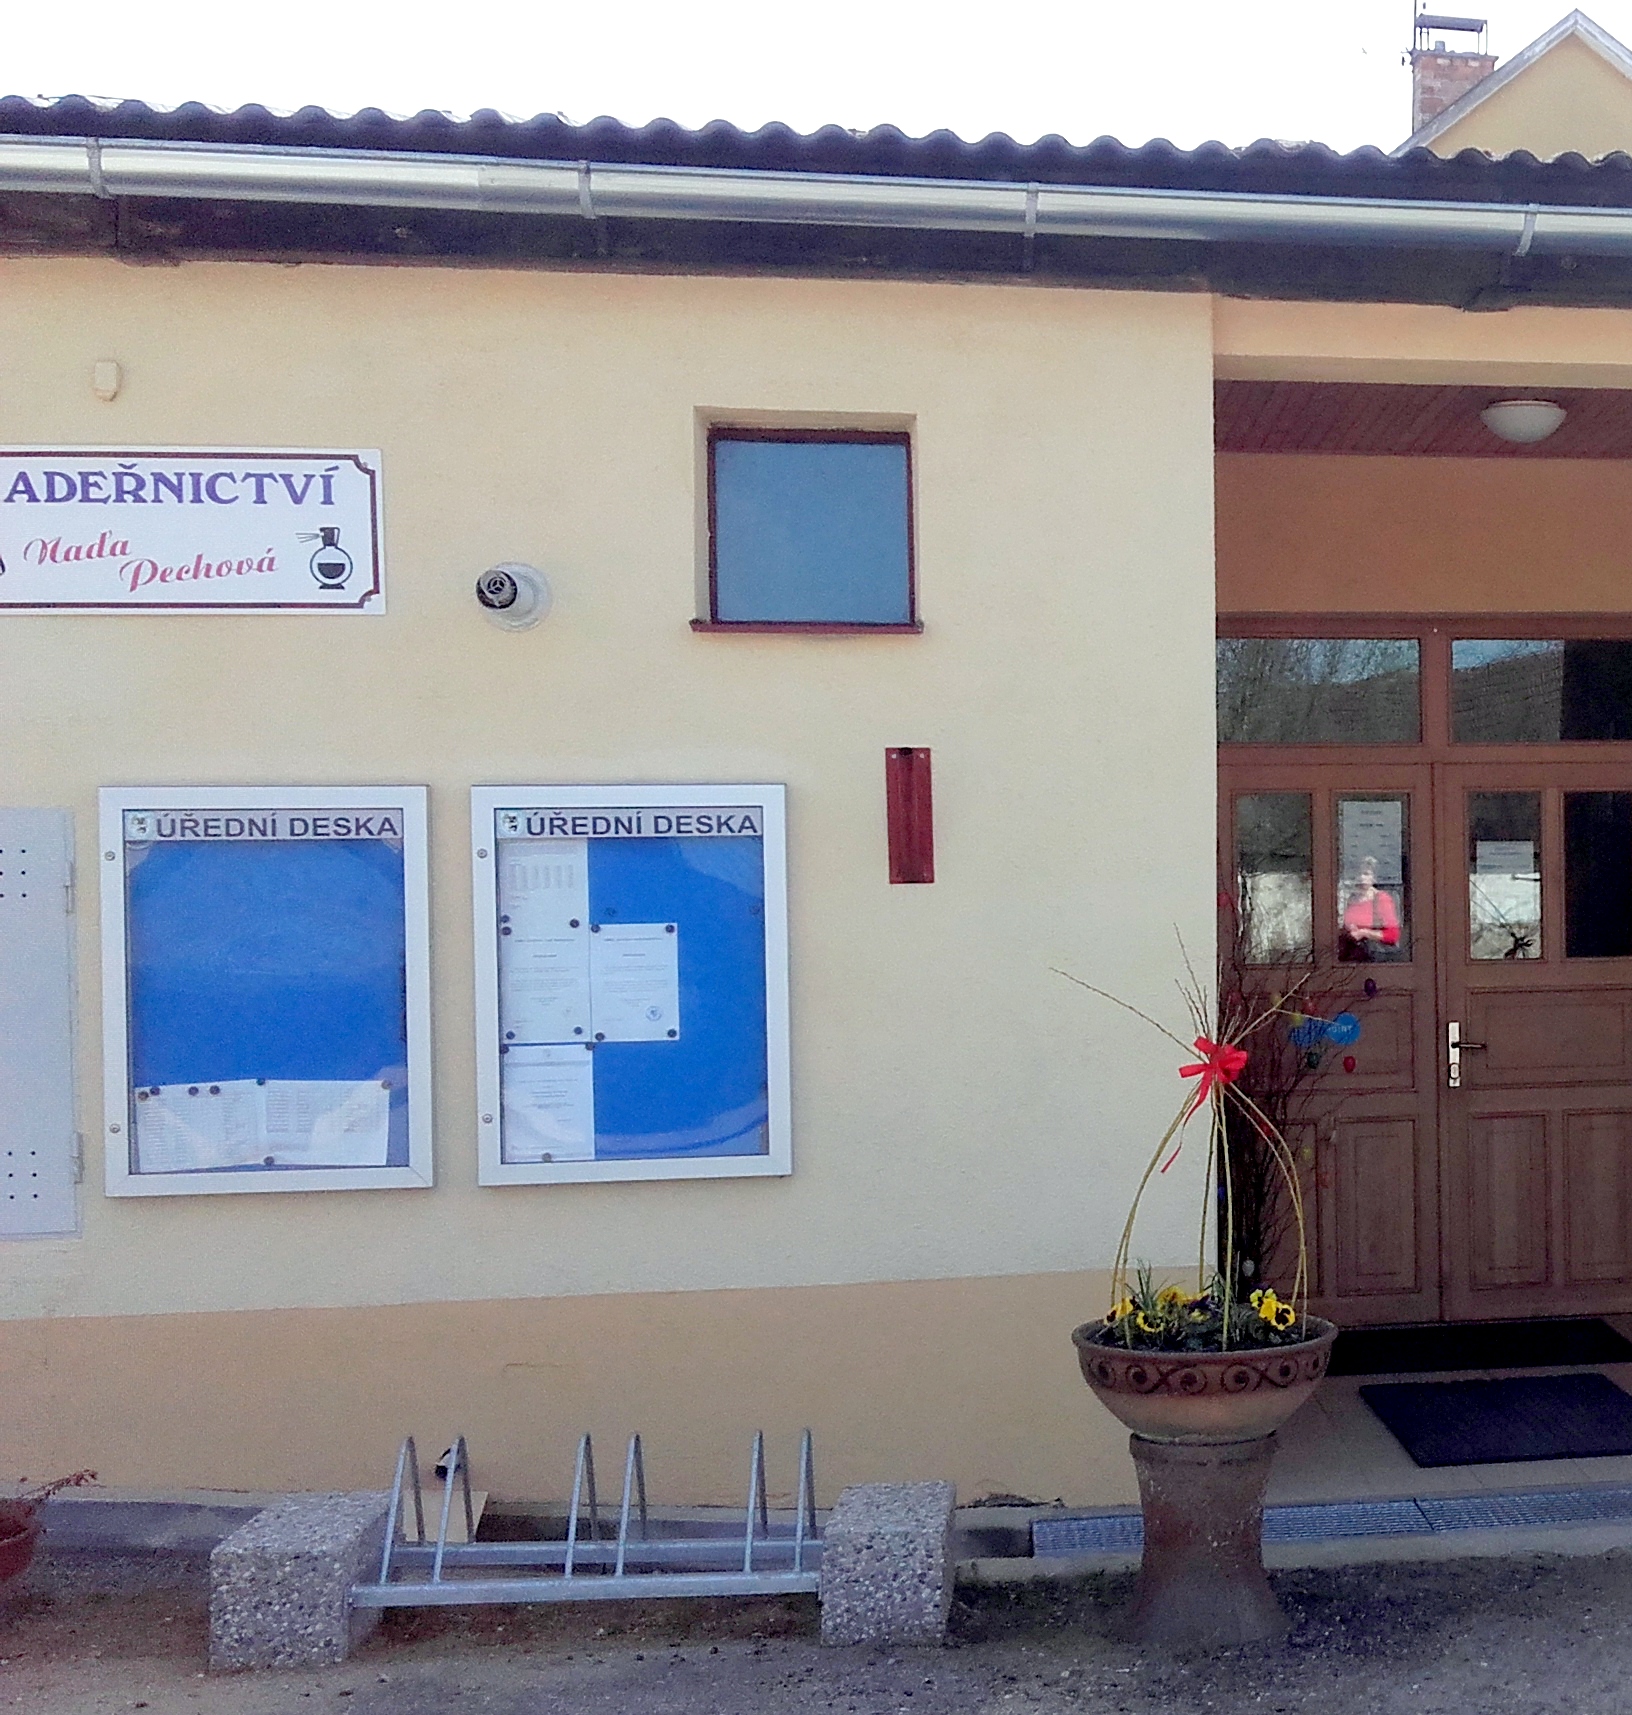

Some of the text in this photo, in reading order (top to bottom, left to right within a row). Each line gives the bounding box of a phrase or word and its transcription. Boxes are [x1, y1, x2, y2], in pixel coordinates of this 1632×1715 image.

[4, 463, 340, 505] ADEŘNICTVÍ
[24, 530, 131, 566] Naďa
[118, 548, 279, 592] Pechová
[156, 812, 399, 838] ÚŘEDNÍ DESKA
[526, 811, 758, 836] ÚŘEDNÍ DESKA
